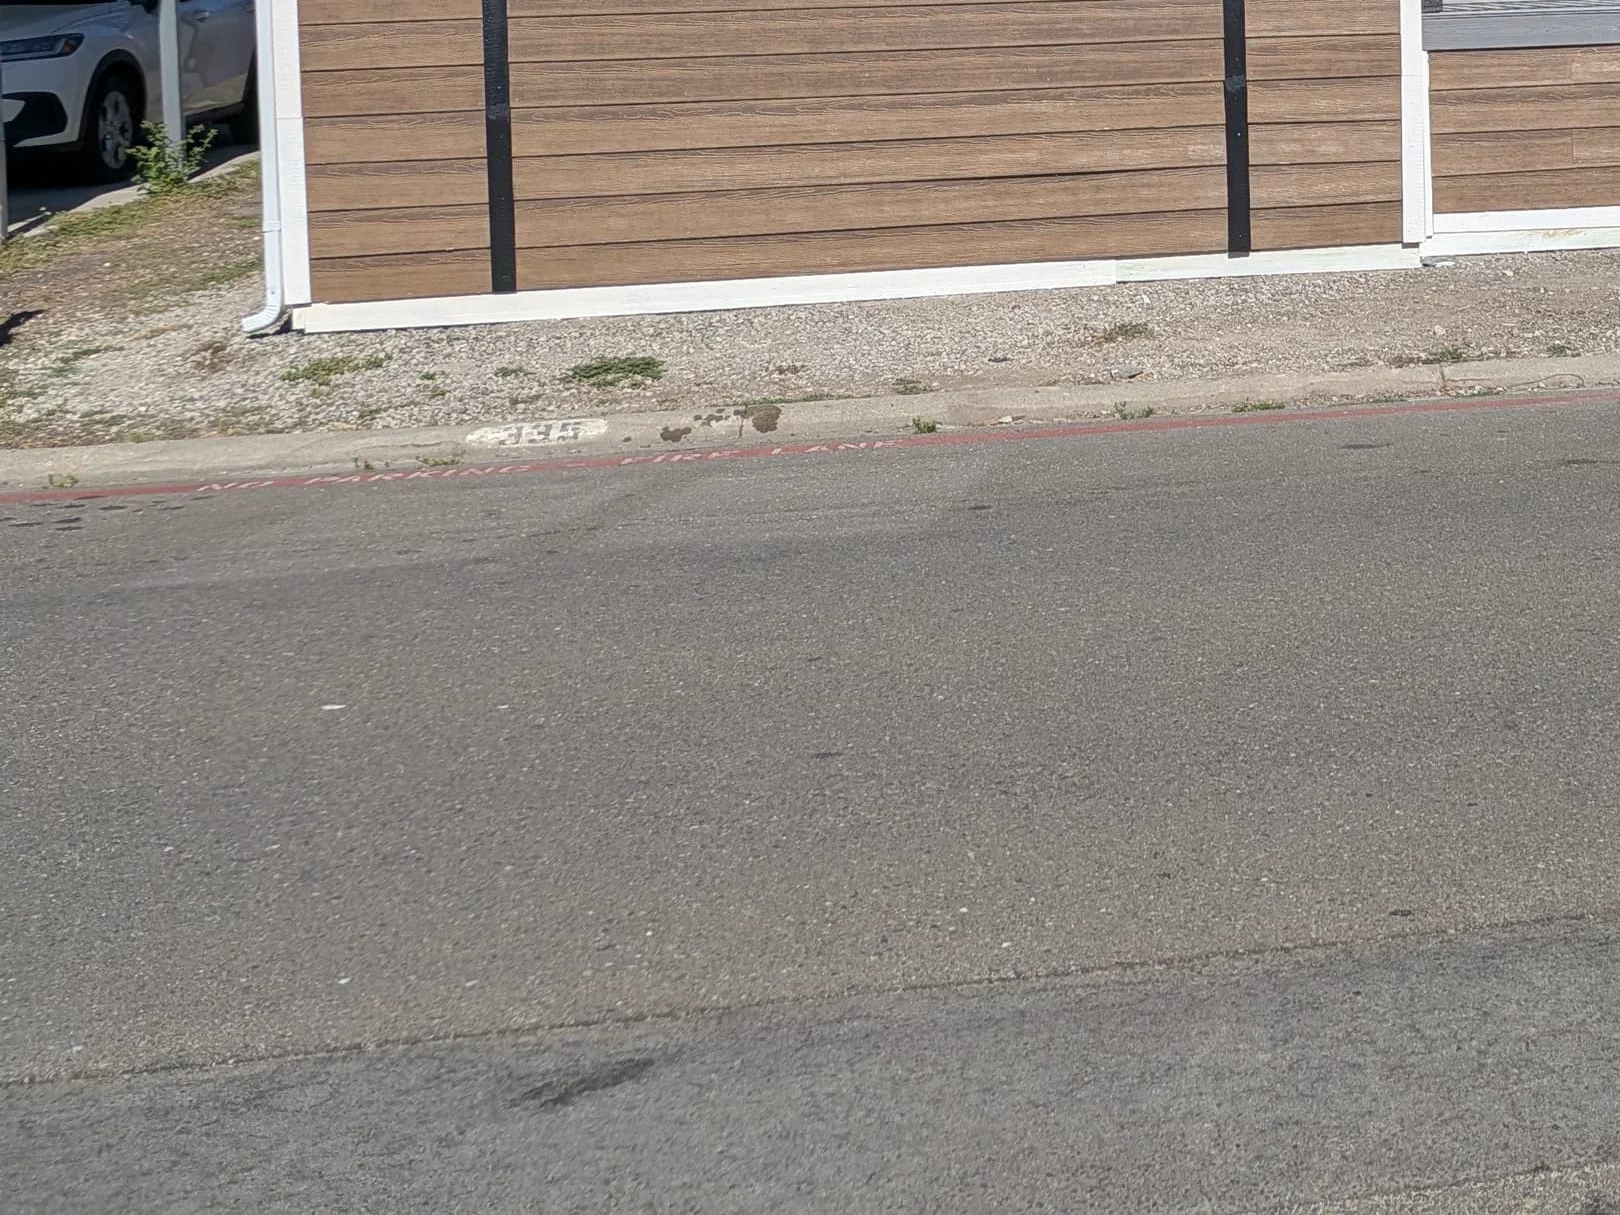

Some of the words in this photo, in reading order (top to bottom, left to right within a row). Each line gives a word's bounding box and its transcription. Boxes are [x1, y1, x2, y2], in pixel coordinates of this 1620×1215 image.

[197, 480, 275, 492] NO
[305, 465, 532, 485] PARKING
[619, 450, 742, 465] FIRE
[771, 439, 903, 455] LANE
